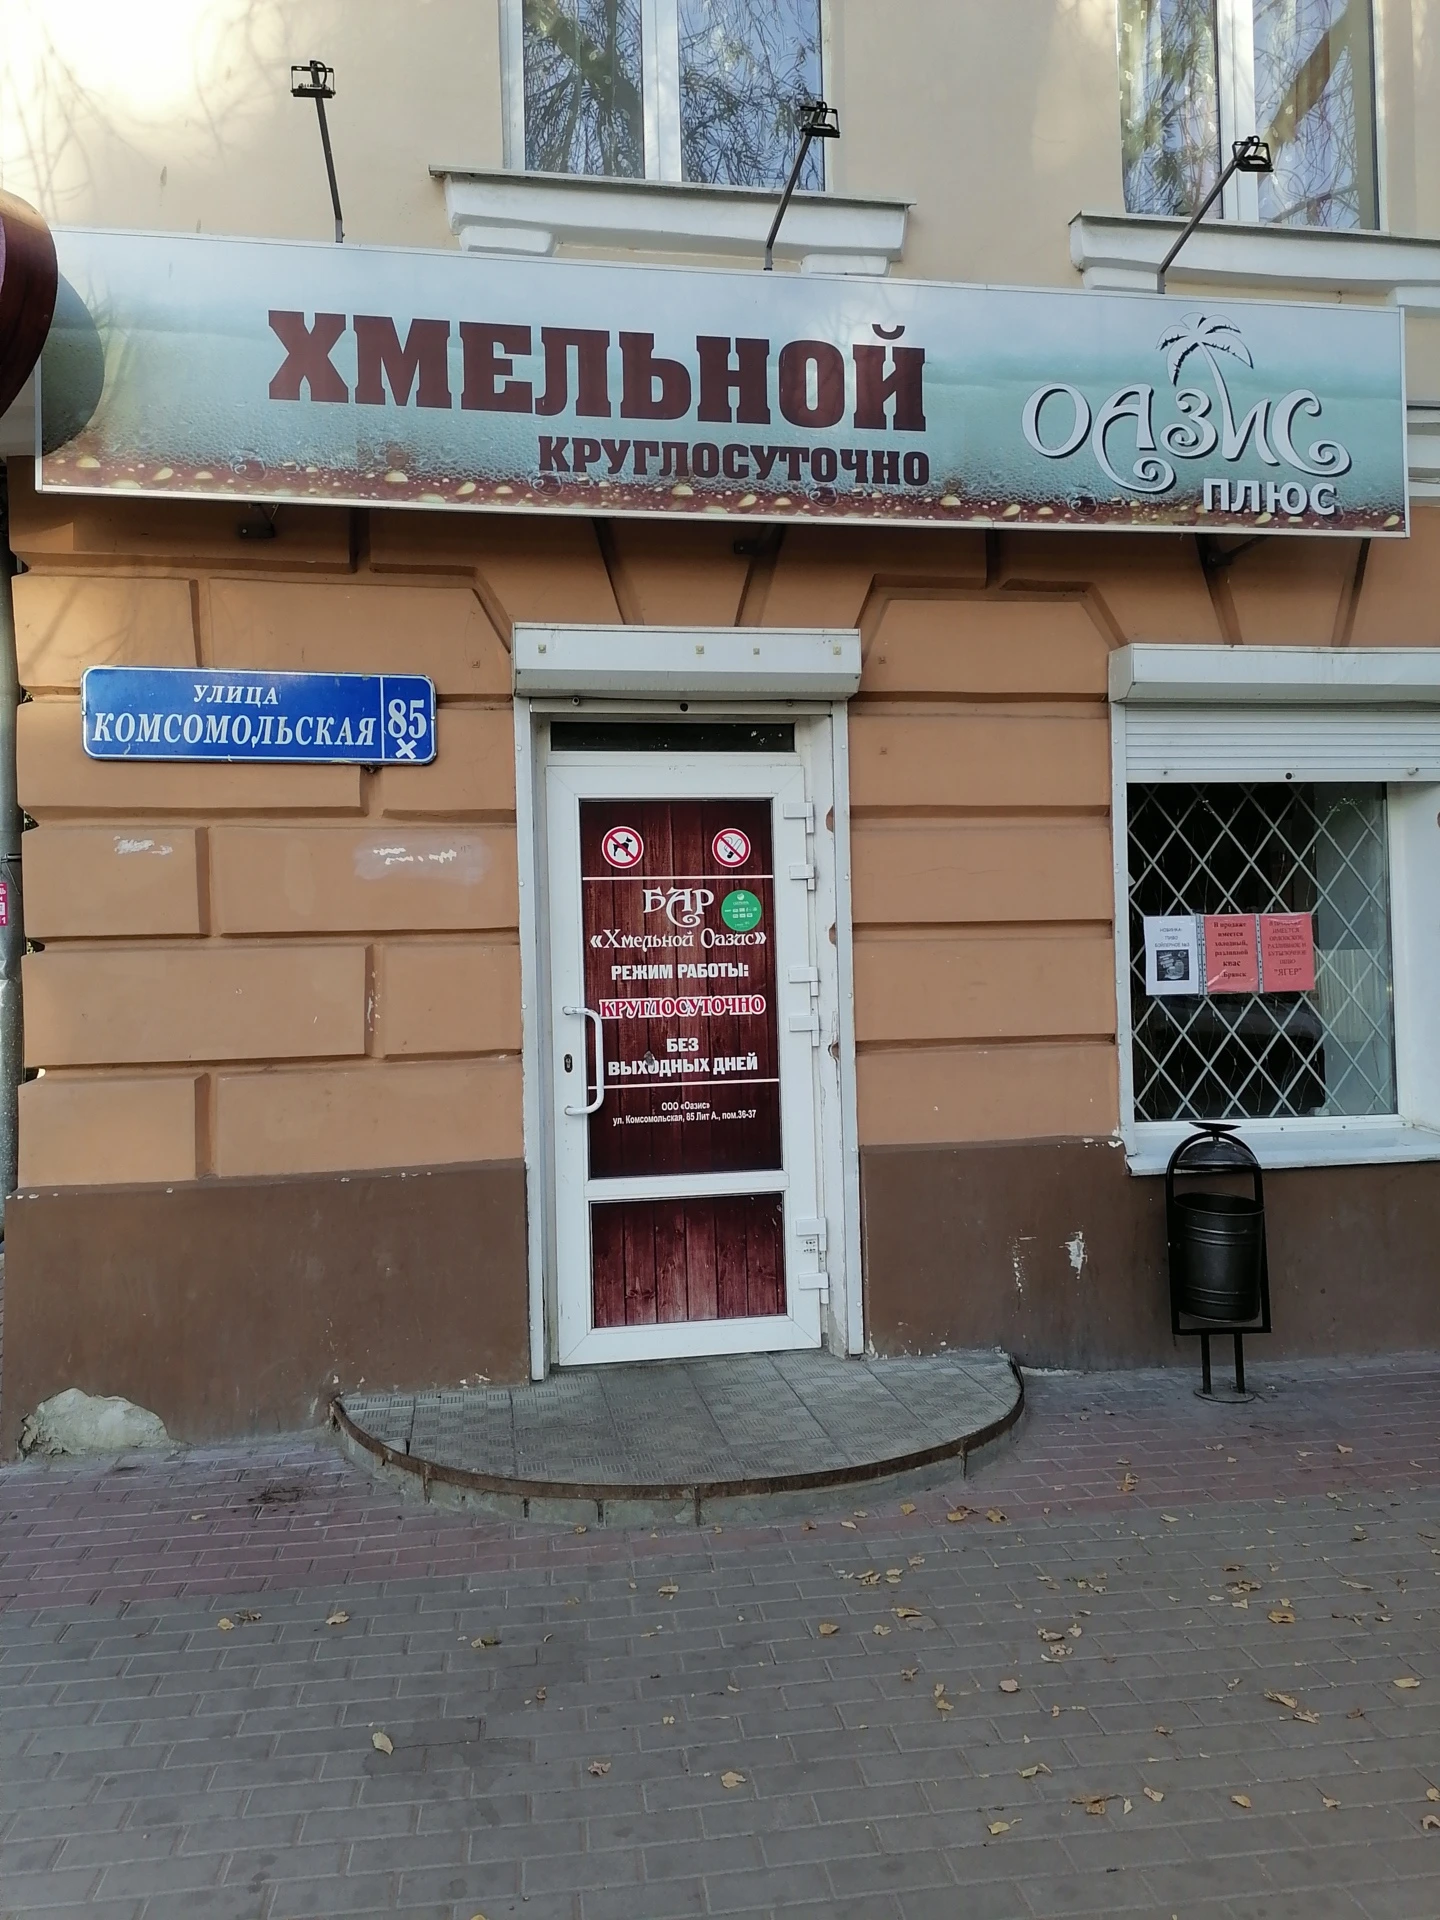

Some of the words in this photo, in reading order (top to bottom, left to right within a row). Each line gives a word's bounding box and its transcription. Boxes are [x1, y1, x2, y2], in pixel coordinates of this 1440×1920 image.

[268, 310, 926, 432] ХМЕЛЬНОЙ
[1021, 345, 1352, 494] ОАЗИС
[538, 435, 930, 486] КРУГЛОСУТОЧНО
[1203, 477, 1339, 516] ПЛЮС
[193, 684, 278, 707] УЛИЦА
[92, 712, 377, 748] КОМСОМОЛЬСКАЯ
[387, 699, 427, 740] 85
[642, 886, 714, 928] БАР
[590, 929, 694, 952] «Хмельной
[701, 928, 767, 949] Оазис»
[611, 964, 673, 980] РЕЖИМ
[678, 963, 749, 978] РАБОТЫ:
[599, 994, 766, 1019] КРУГЛОСУТОЧНО
[666, 1037, 699, 1052] БЕЗ
[608, 1057, 710, 1077] ВЫХОДНЫХ
[713, 1052, 758, 1075] ДНЕЙ
[612, 1116, 625, 1126] ул.
[625, 1113, 685, 1124] Комсомольская,
[686, 1112, 695, 1121] 85
[696, 1111, 710, 1121] Лит
[661, 1102, 679, 1111] ООО
[680, 1101, 710, 1110] «Оазис»
